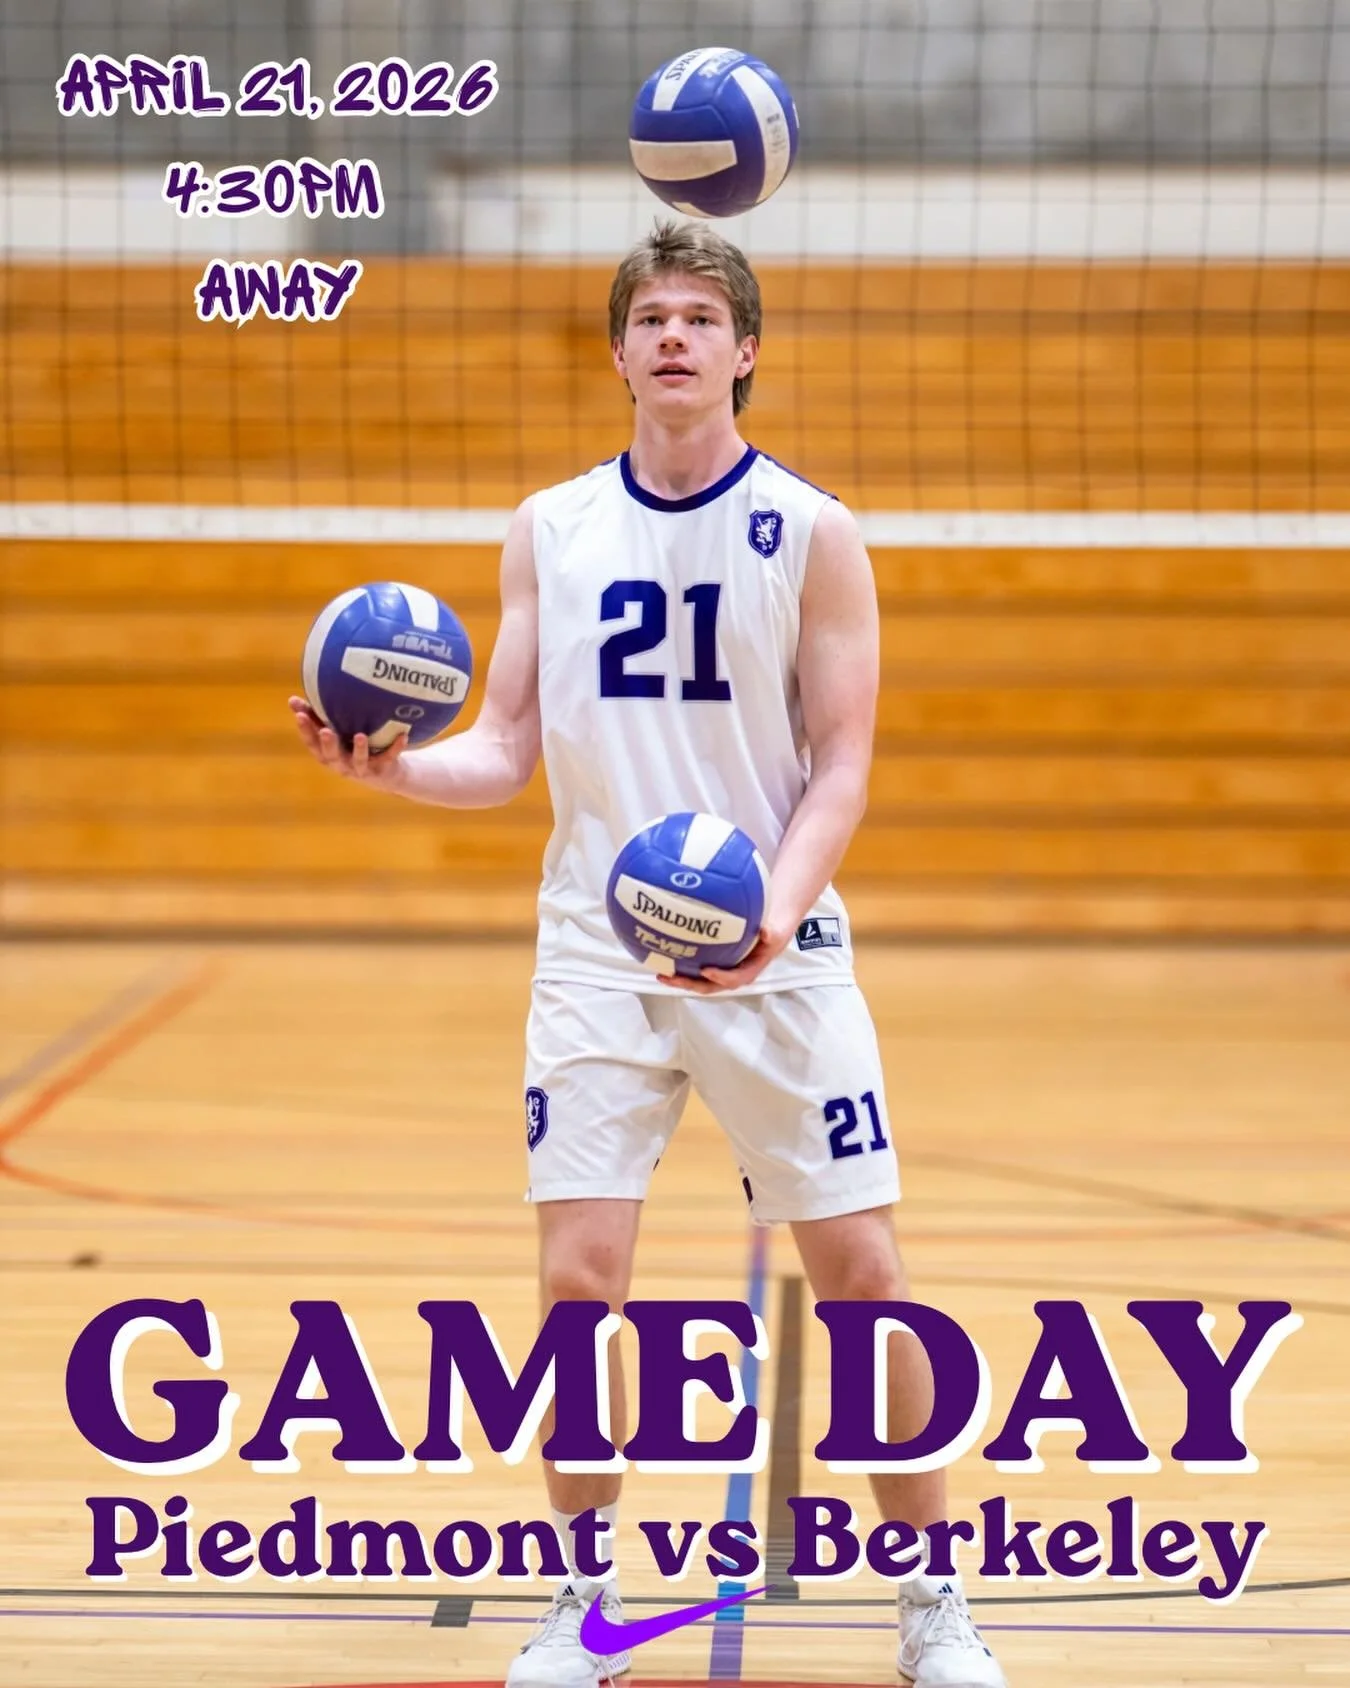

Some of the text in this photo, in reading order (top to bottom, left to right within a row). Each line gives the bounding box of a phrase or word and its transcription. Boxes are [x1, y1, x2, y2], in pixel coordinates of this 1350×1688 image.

[600, 580, 731, 700] 21
[373, 656, 457, 697] SPALDING
[633, 891, 722, 939] SPALDING
[823, 1091, 888, 1159] 21
